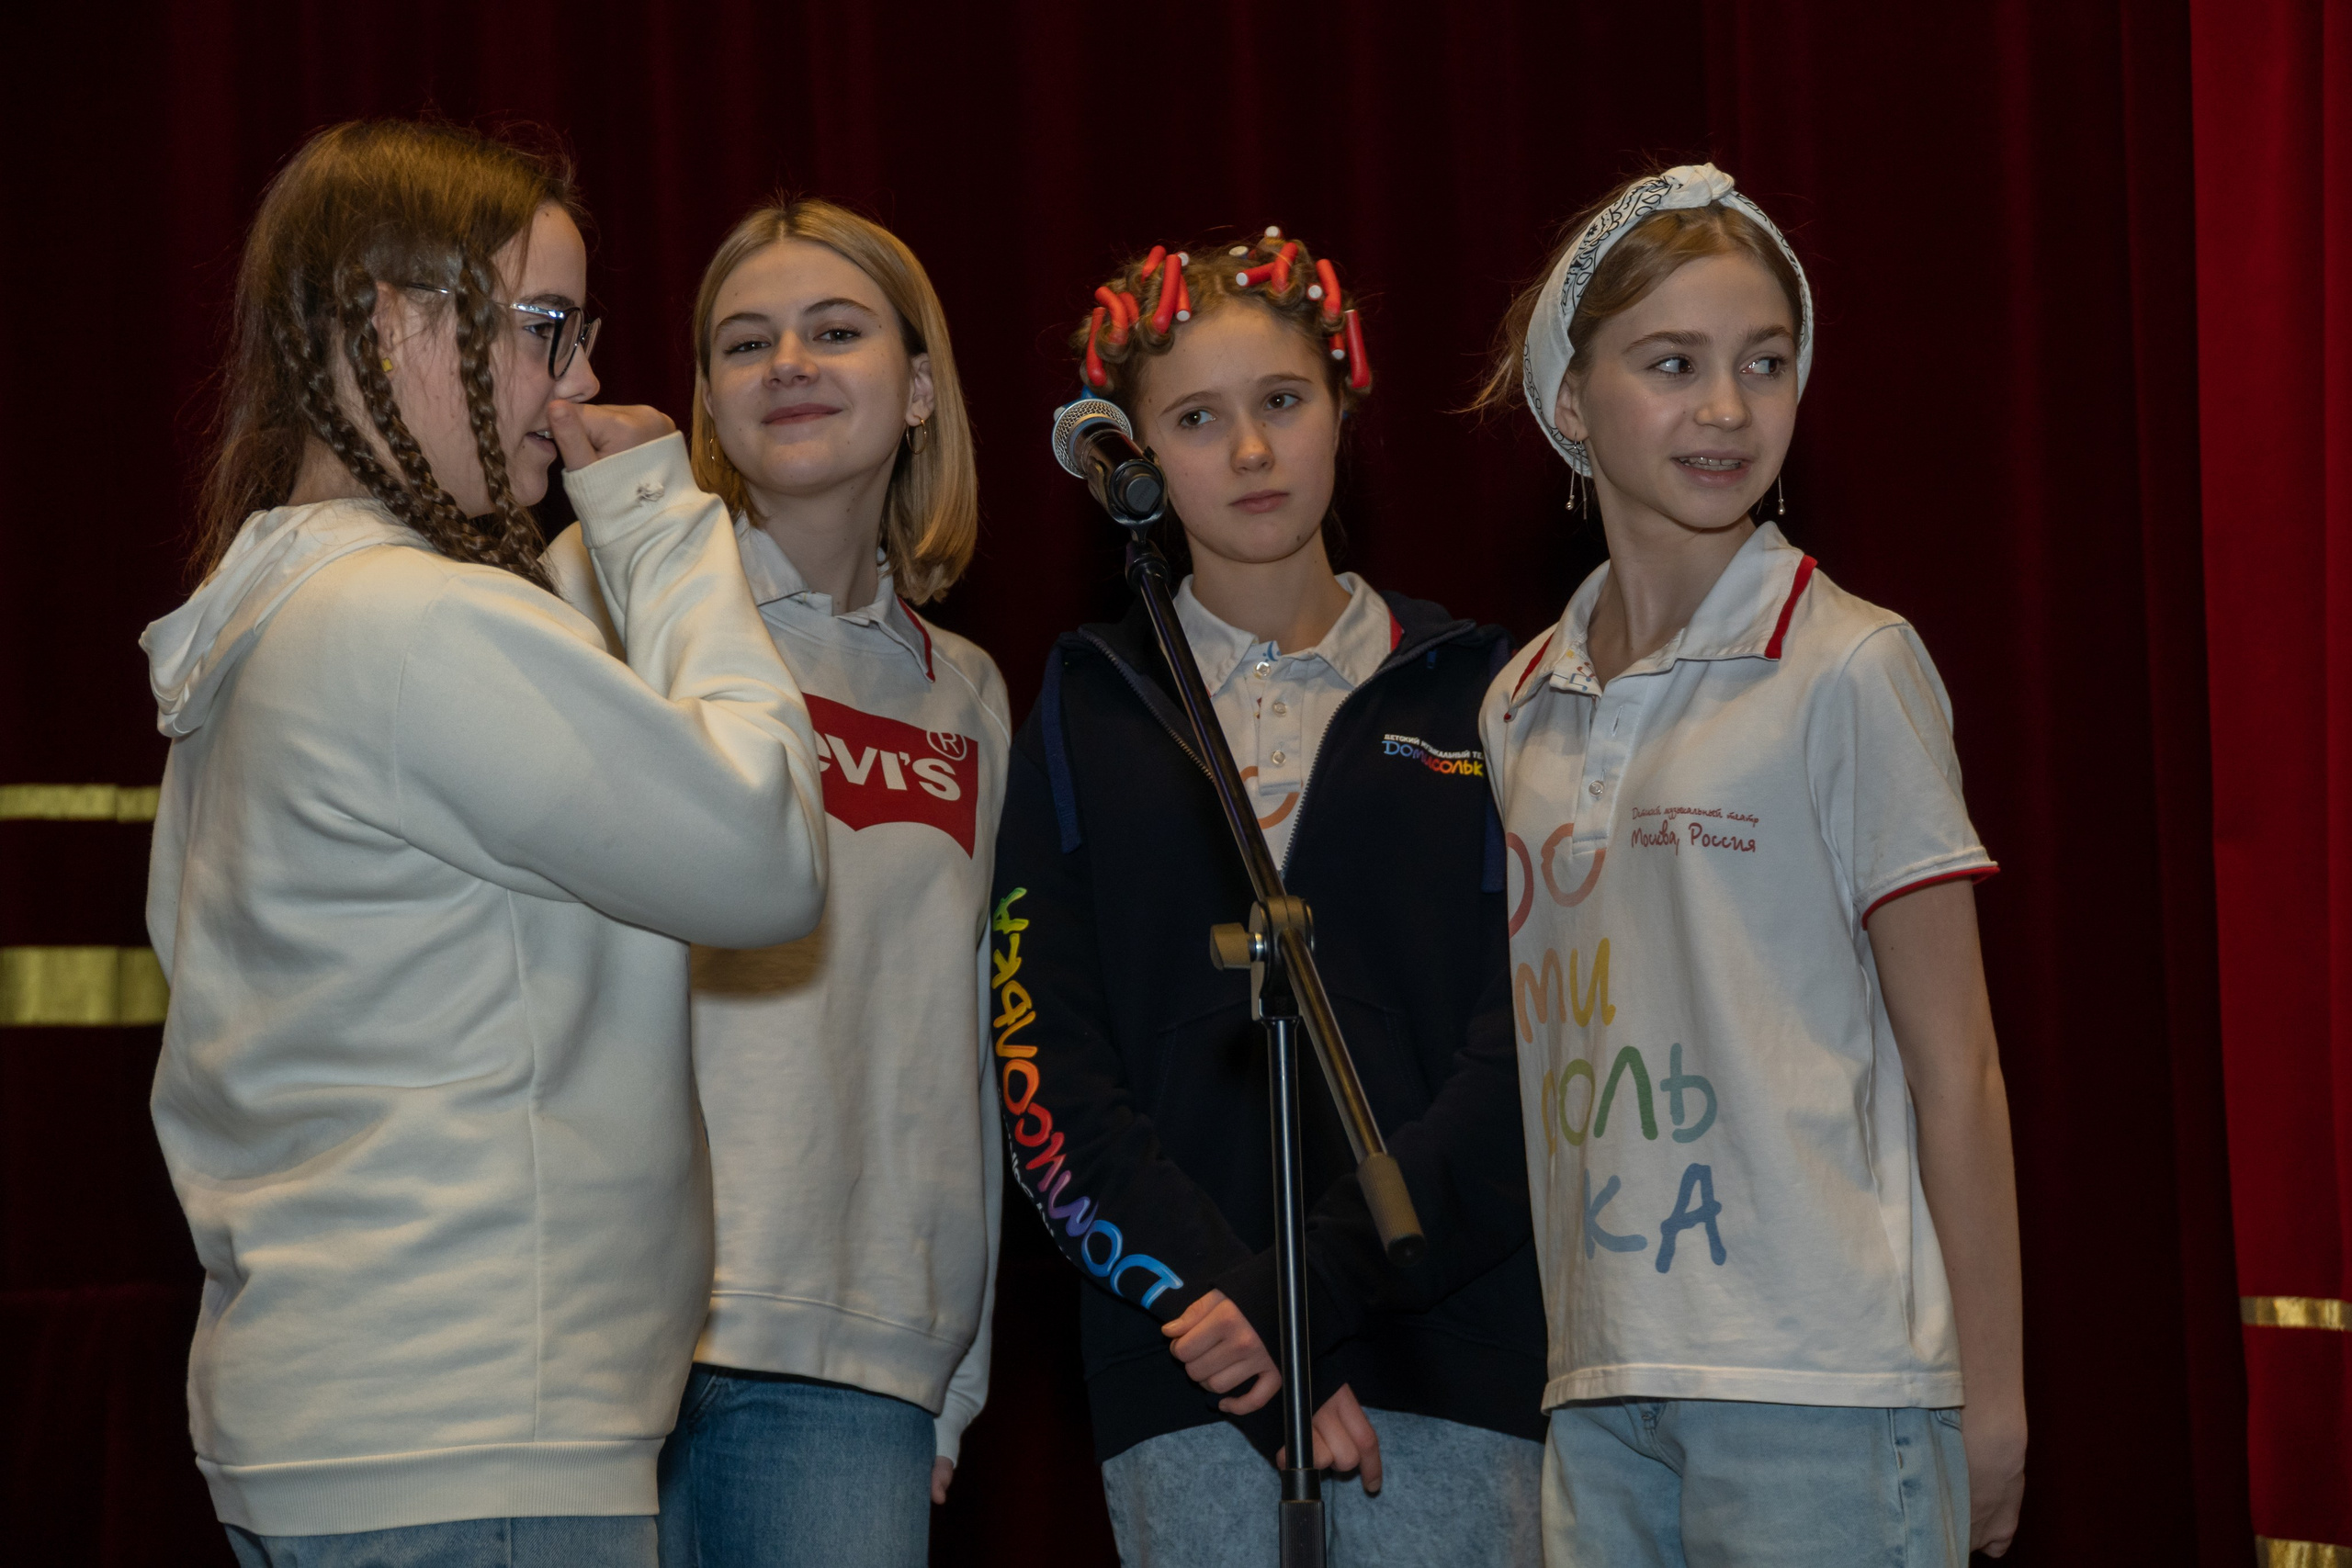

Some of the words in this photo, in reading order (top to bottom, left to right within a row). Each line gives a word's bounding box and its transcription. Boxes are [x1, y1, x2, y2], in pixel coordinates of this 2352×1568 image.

[1384, 734, 1420, 745] ДЕТСКИЙ
[1381, 740, 1484, 777] ДОМИСОЛЬК
[1726, 812, 1759, 828] театр
[1631, 819, 1679, 856] Москва,
[1688, 822, 1756, 853] Россия
